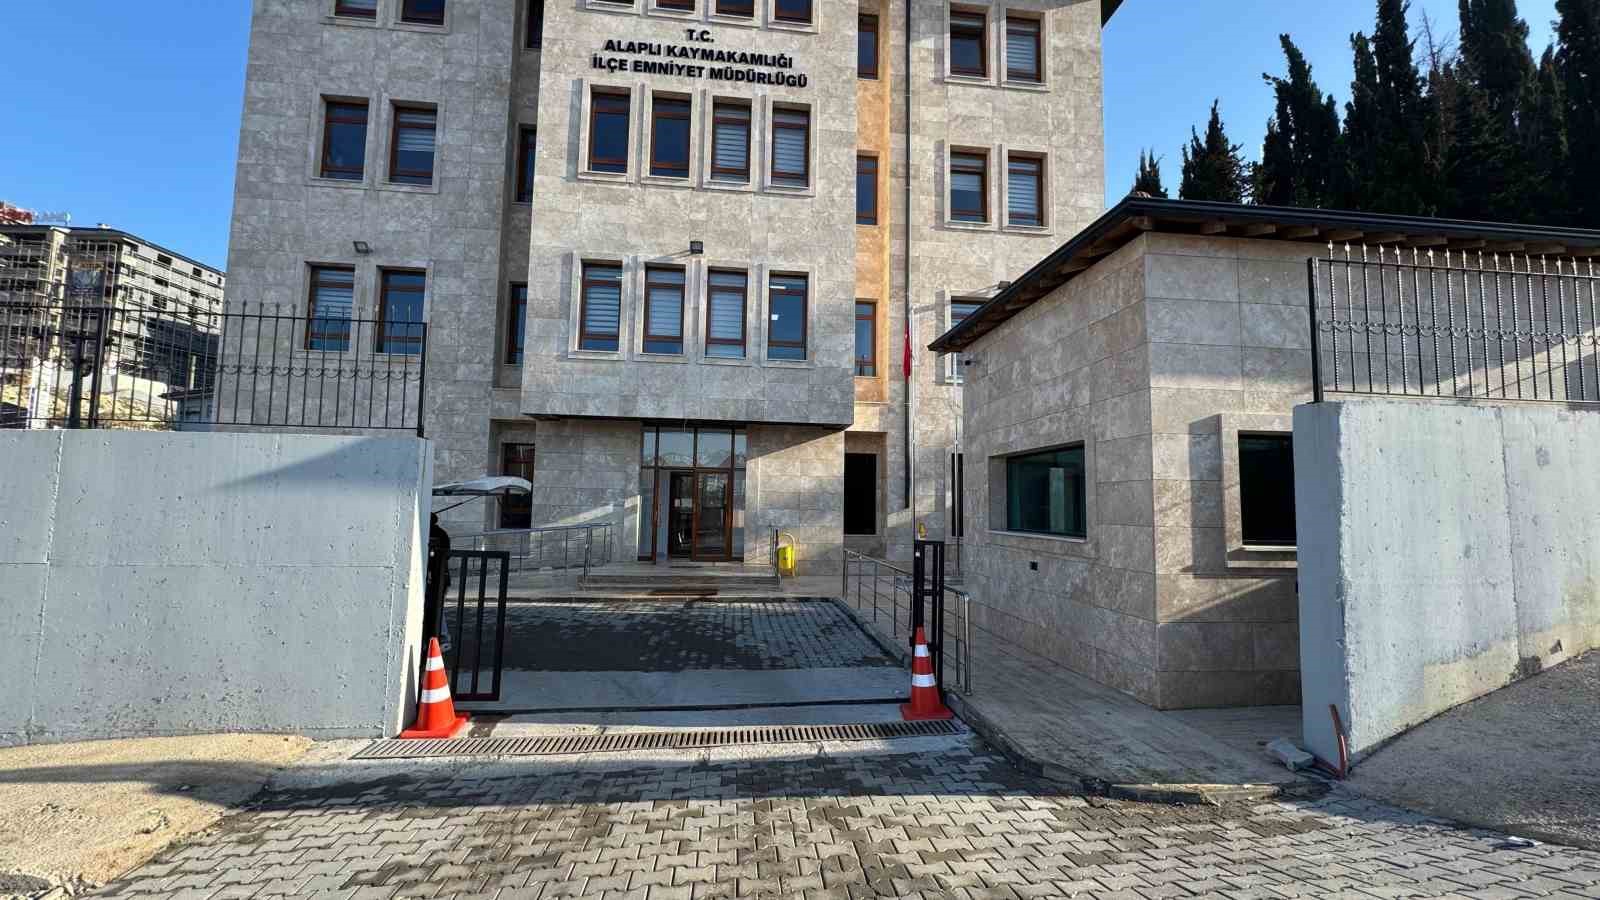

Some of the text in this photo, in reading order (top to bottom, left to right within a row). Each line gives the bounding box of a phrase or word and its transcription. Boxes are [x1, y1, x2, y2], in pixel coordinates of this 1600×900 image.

[686, 28, 715, 43] T.C.
[592, 53, 628, 73] İLÇE
[632, 60, 705, 78] EMNİYET
[604, 39, 793, 69] ALAPLI KAYMAKAMLIĞI
